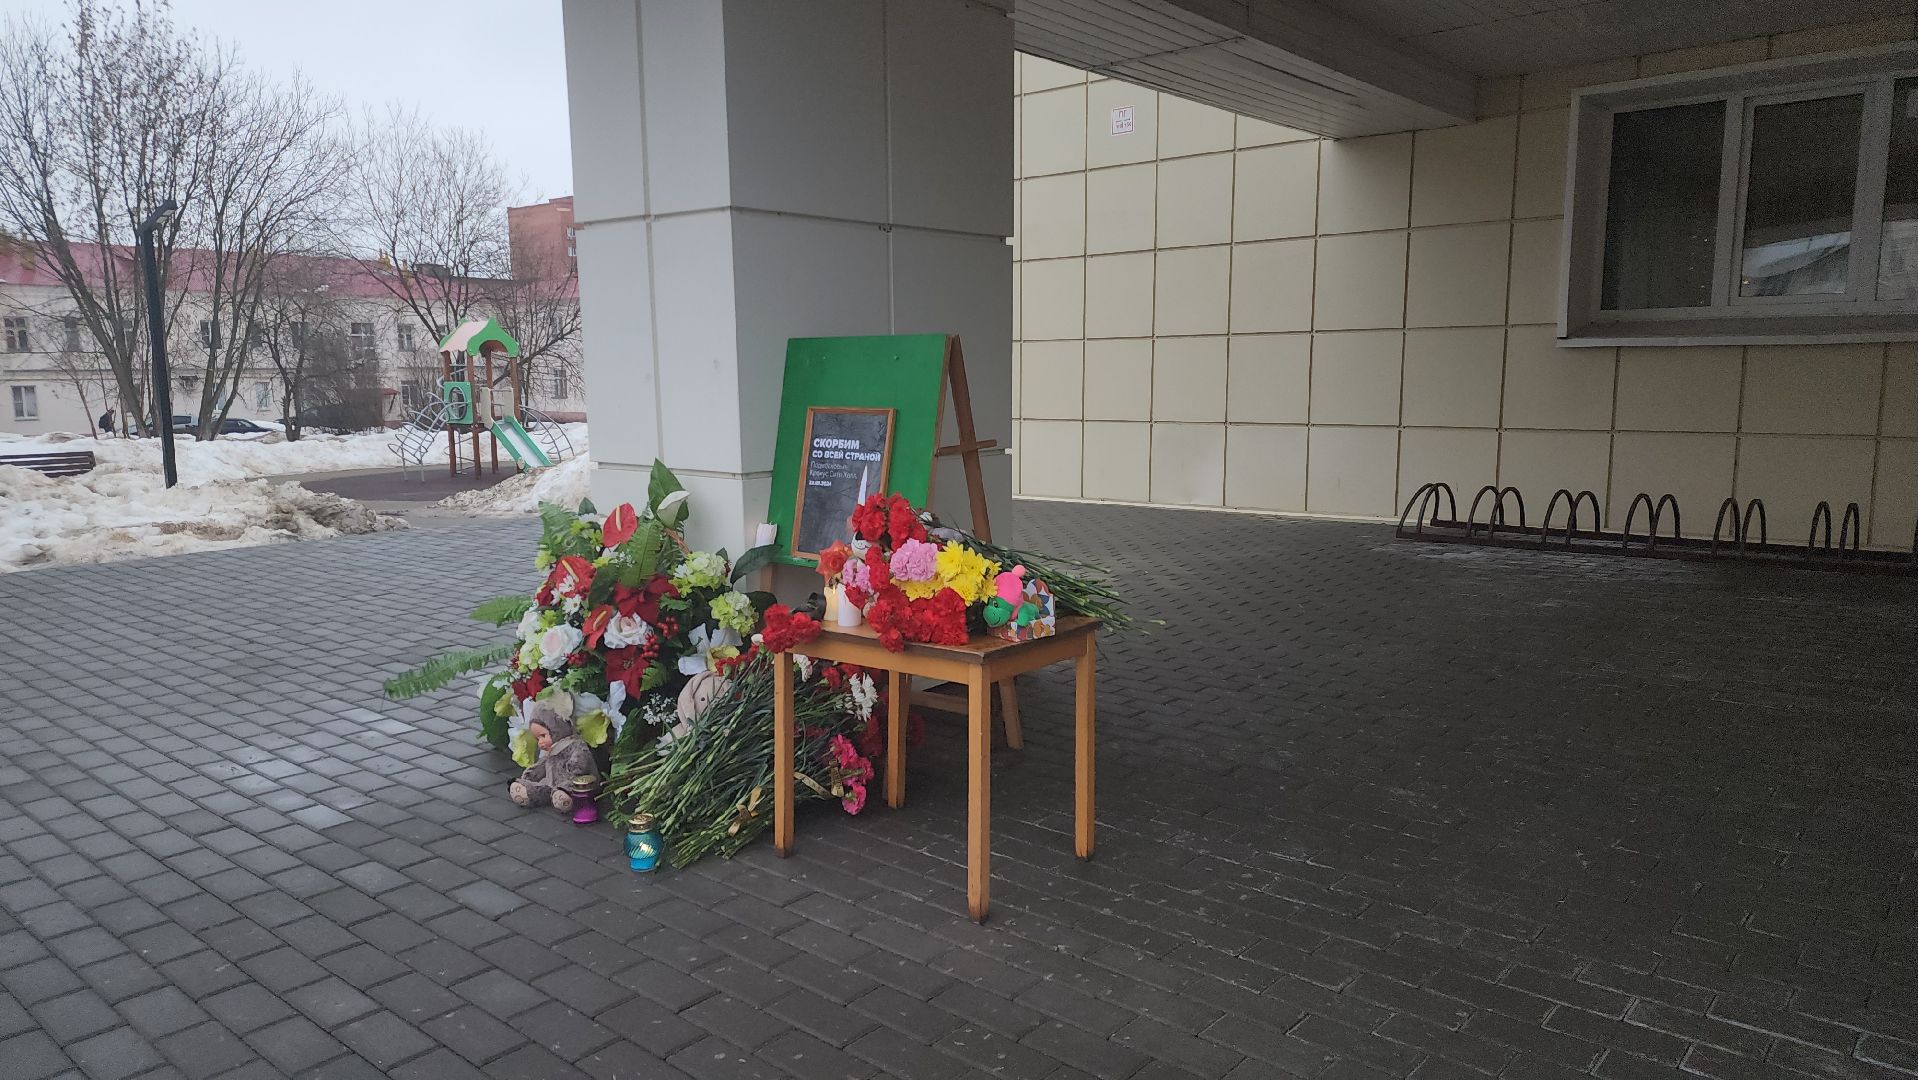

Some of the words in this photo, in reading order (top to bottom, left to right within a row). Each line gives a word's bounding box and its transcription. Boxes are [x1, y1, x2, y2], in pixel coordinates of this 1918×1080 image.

[813, 438, 860, 449] СКОРБИМ
[812, 450, 823, 458] СО
[824, 450, 844, 459] ВСЕЙ
[845, 452, 881, 461] СТРАНОЙ
